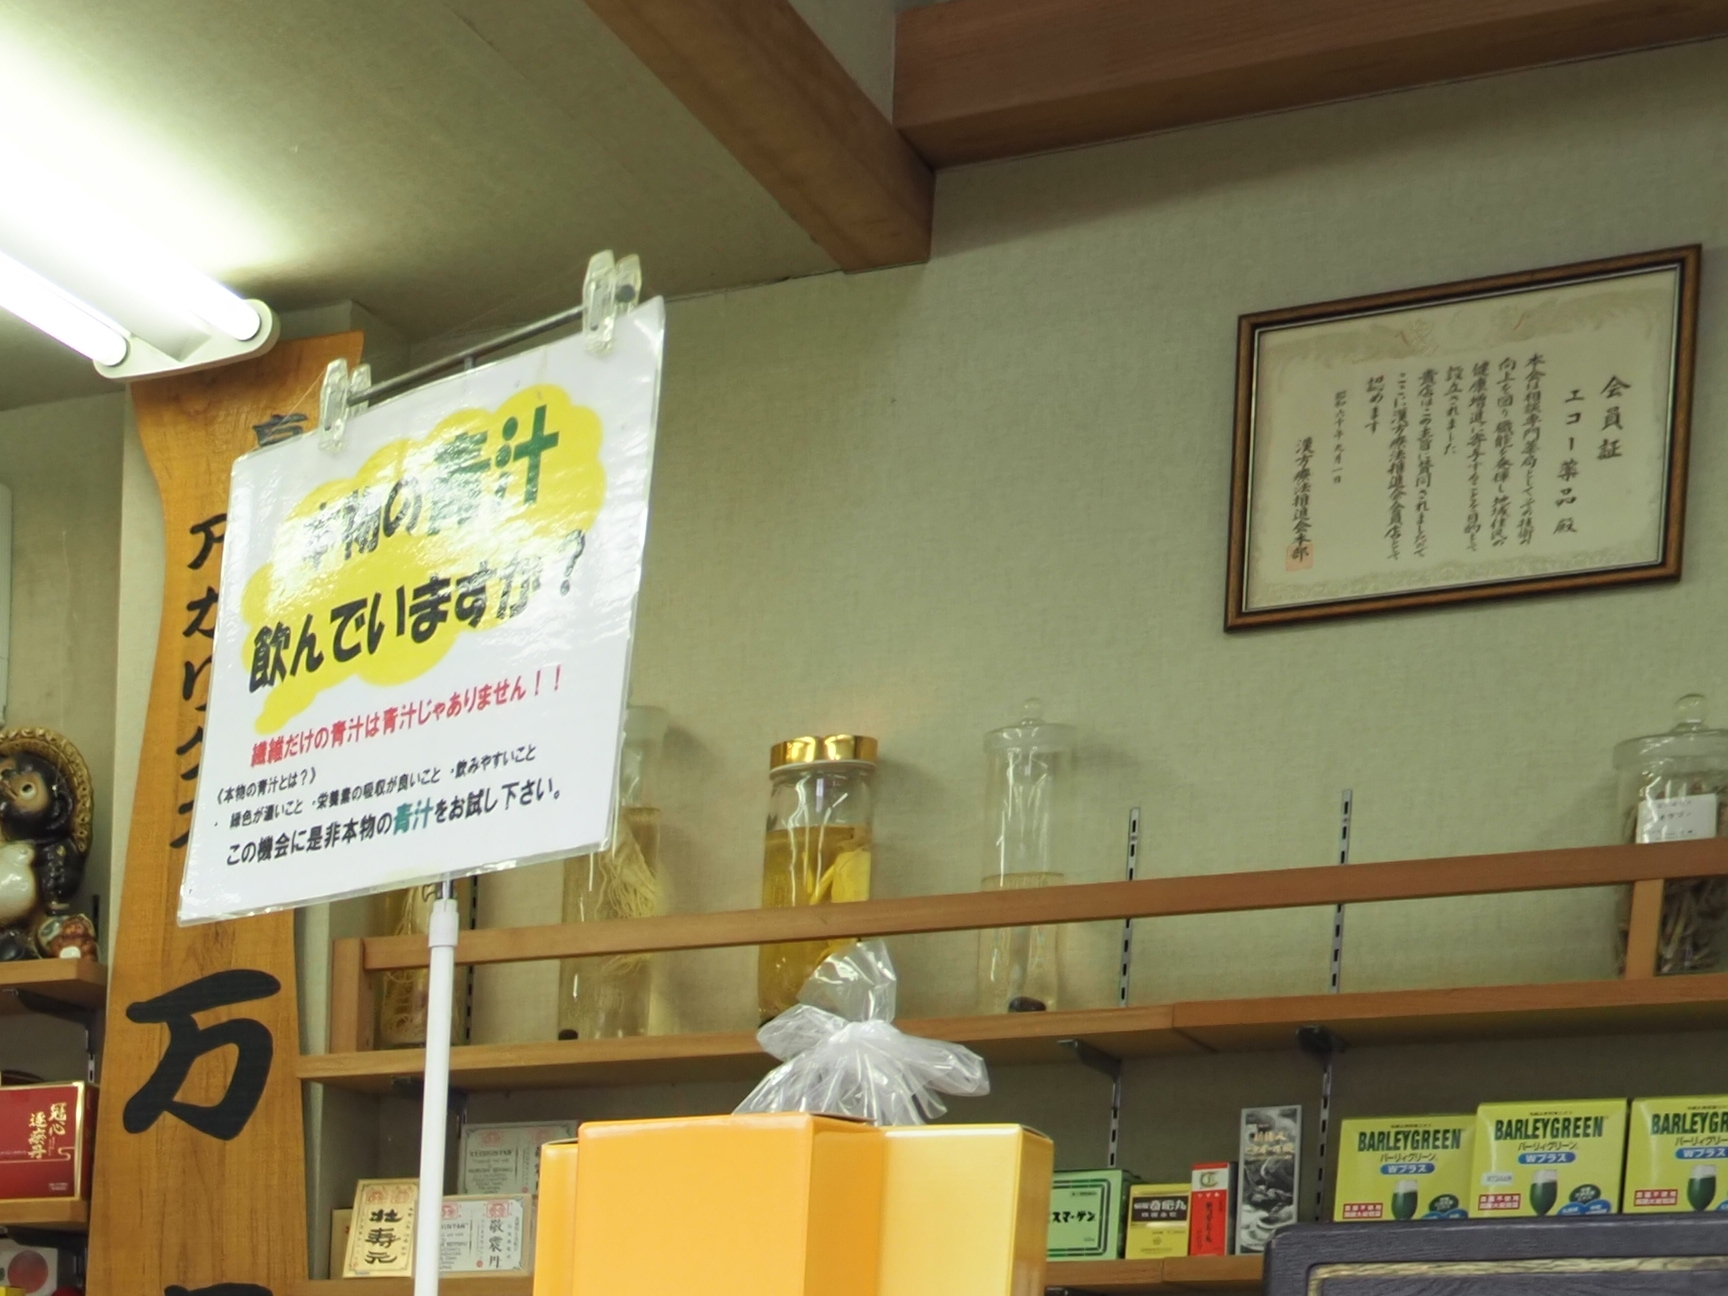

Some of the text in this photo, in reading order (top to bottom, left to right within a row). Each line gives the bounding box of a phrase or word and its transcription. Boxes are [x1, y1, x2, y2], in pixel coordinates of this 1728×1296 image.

[1597, 374, 1633, 461] 会員証
[1357, 1127, 1463, 1152] BARLEYGREEN
[1493, 1115, 1605, 1142] BARLEYGREEN
